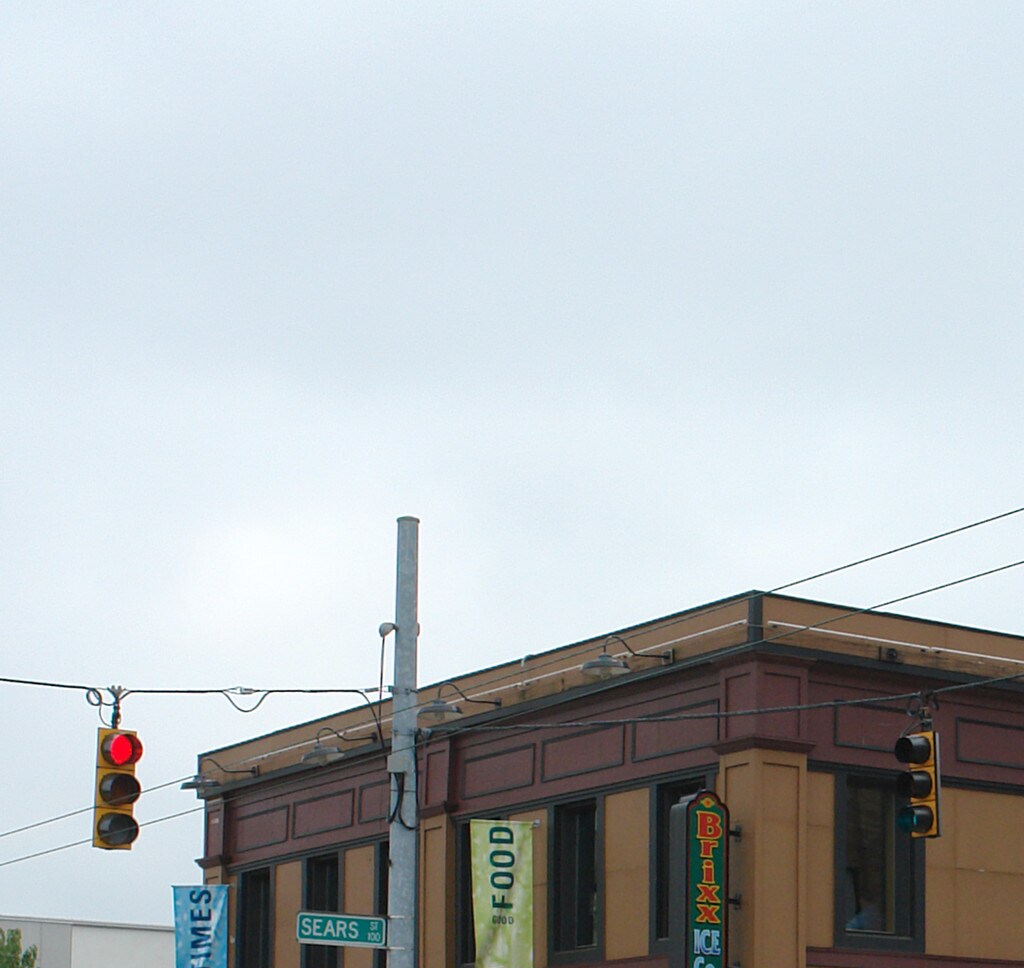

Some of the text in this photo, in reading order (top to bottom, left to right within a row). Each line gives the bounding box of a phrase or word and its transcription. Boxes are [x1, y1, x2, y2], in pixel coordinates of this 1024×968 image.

[489, 826, 515, 910] FOOD
[696, 810, 722, 924] Brixx
[301, 918, 379, 939] SEARS ST
[367, 932, 380, 942] 100
[693, 929, 721, 955] ICE
